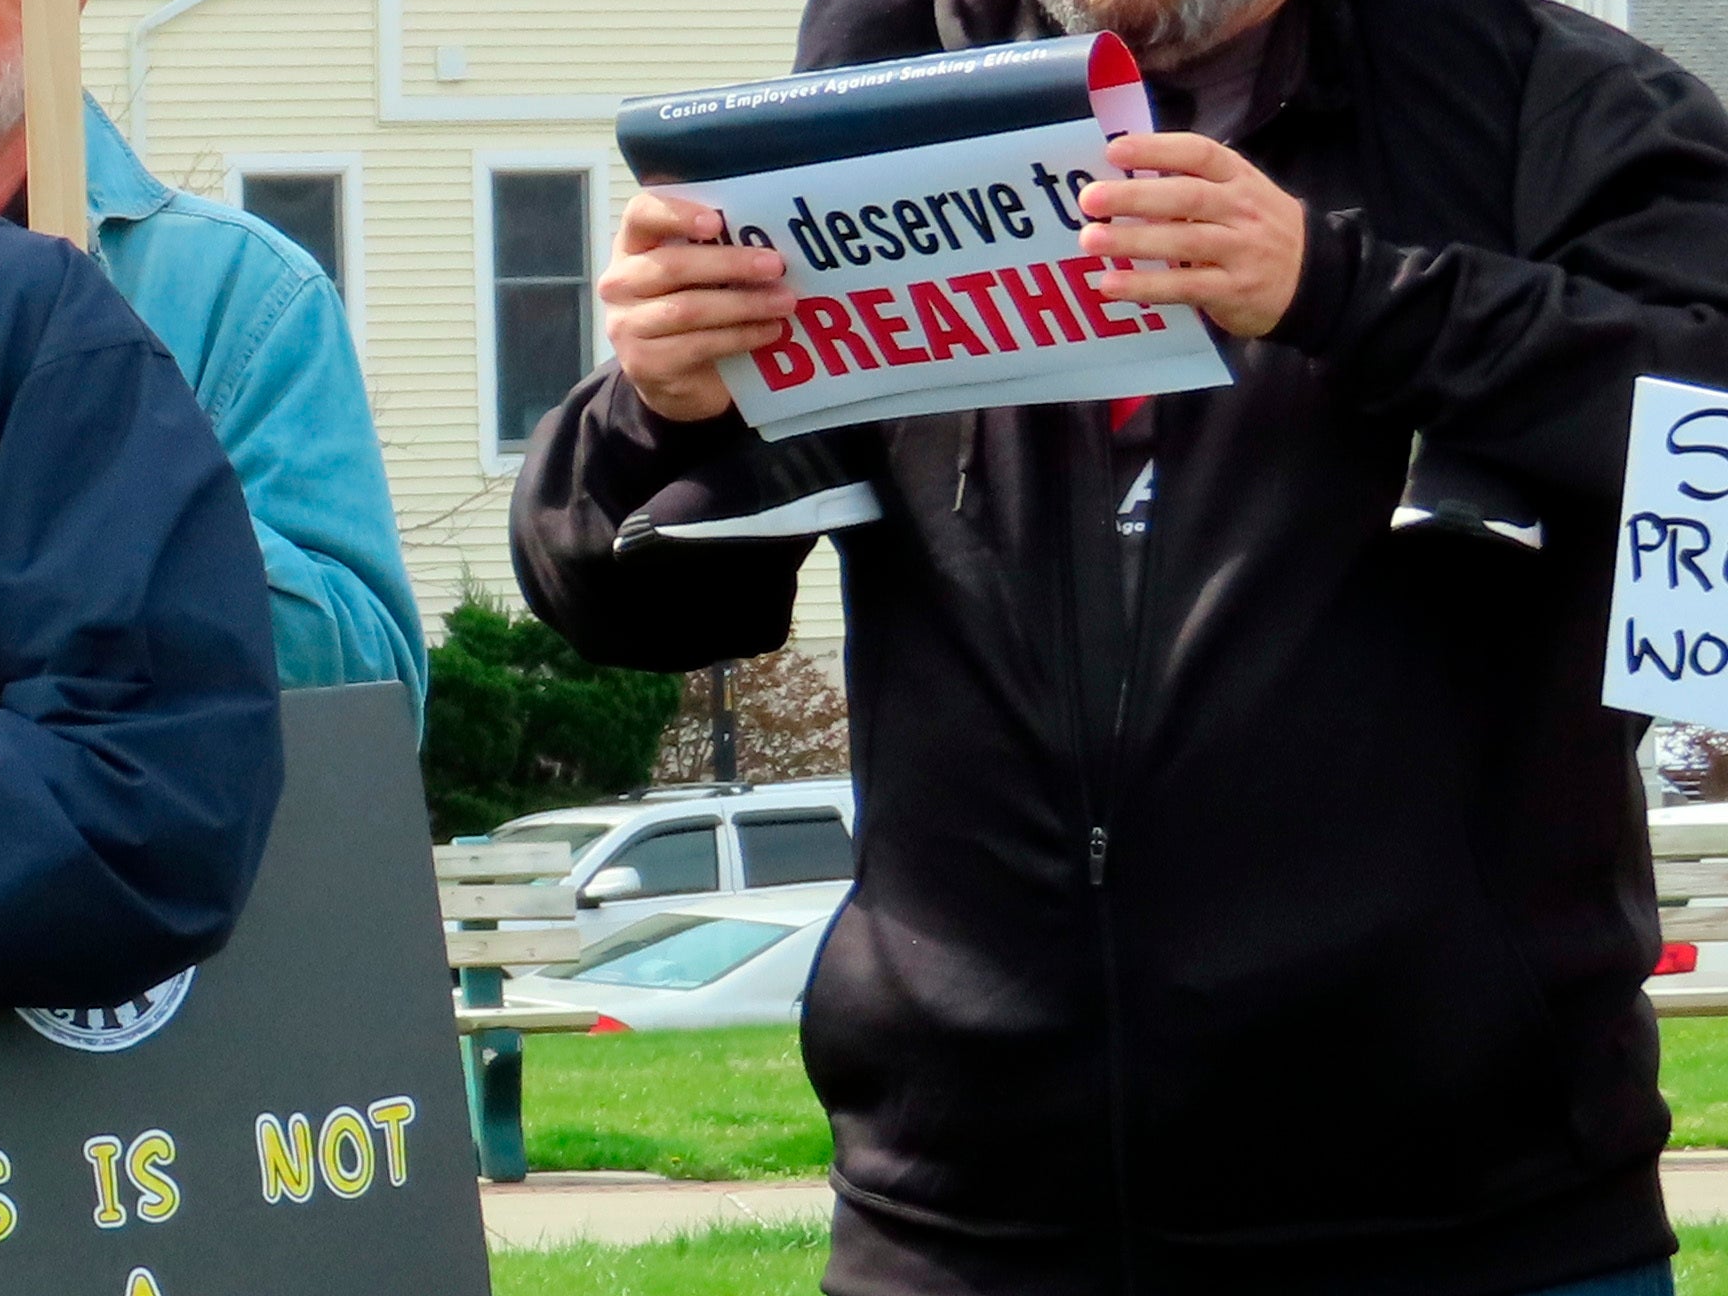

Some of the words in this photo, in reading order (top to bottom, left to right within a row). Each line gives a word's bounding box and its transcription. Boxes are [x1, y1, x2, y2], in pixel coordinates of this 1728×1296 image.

[658, 100, 719, 122] Casino
[724, 82, 819, 111] Employees
[825, 69, 893, 97] Against
[899, 56, 976, 84] Smoking
[982, 45, 1048, 69] Effects
[787, 182, 1035, 272] deserve
[82, 1127, 181, 1232] IS
[252, 1096, 415, 1205] NOT
